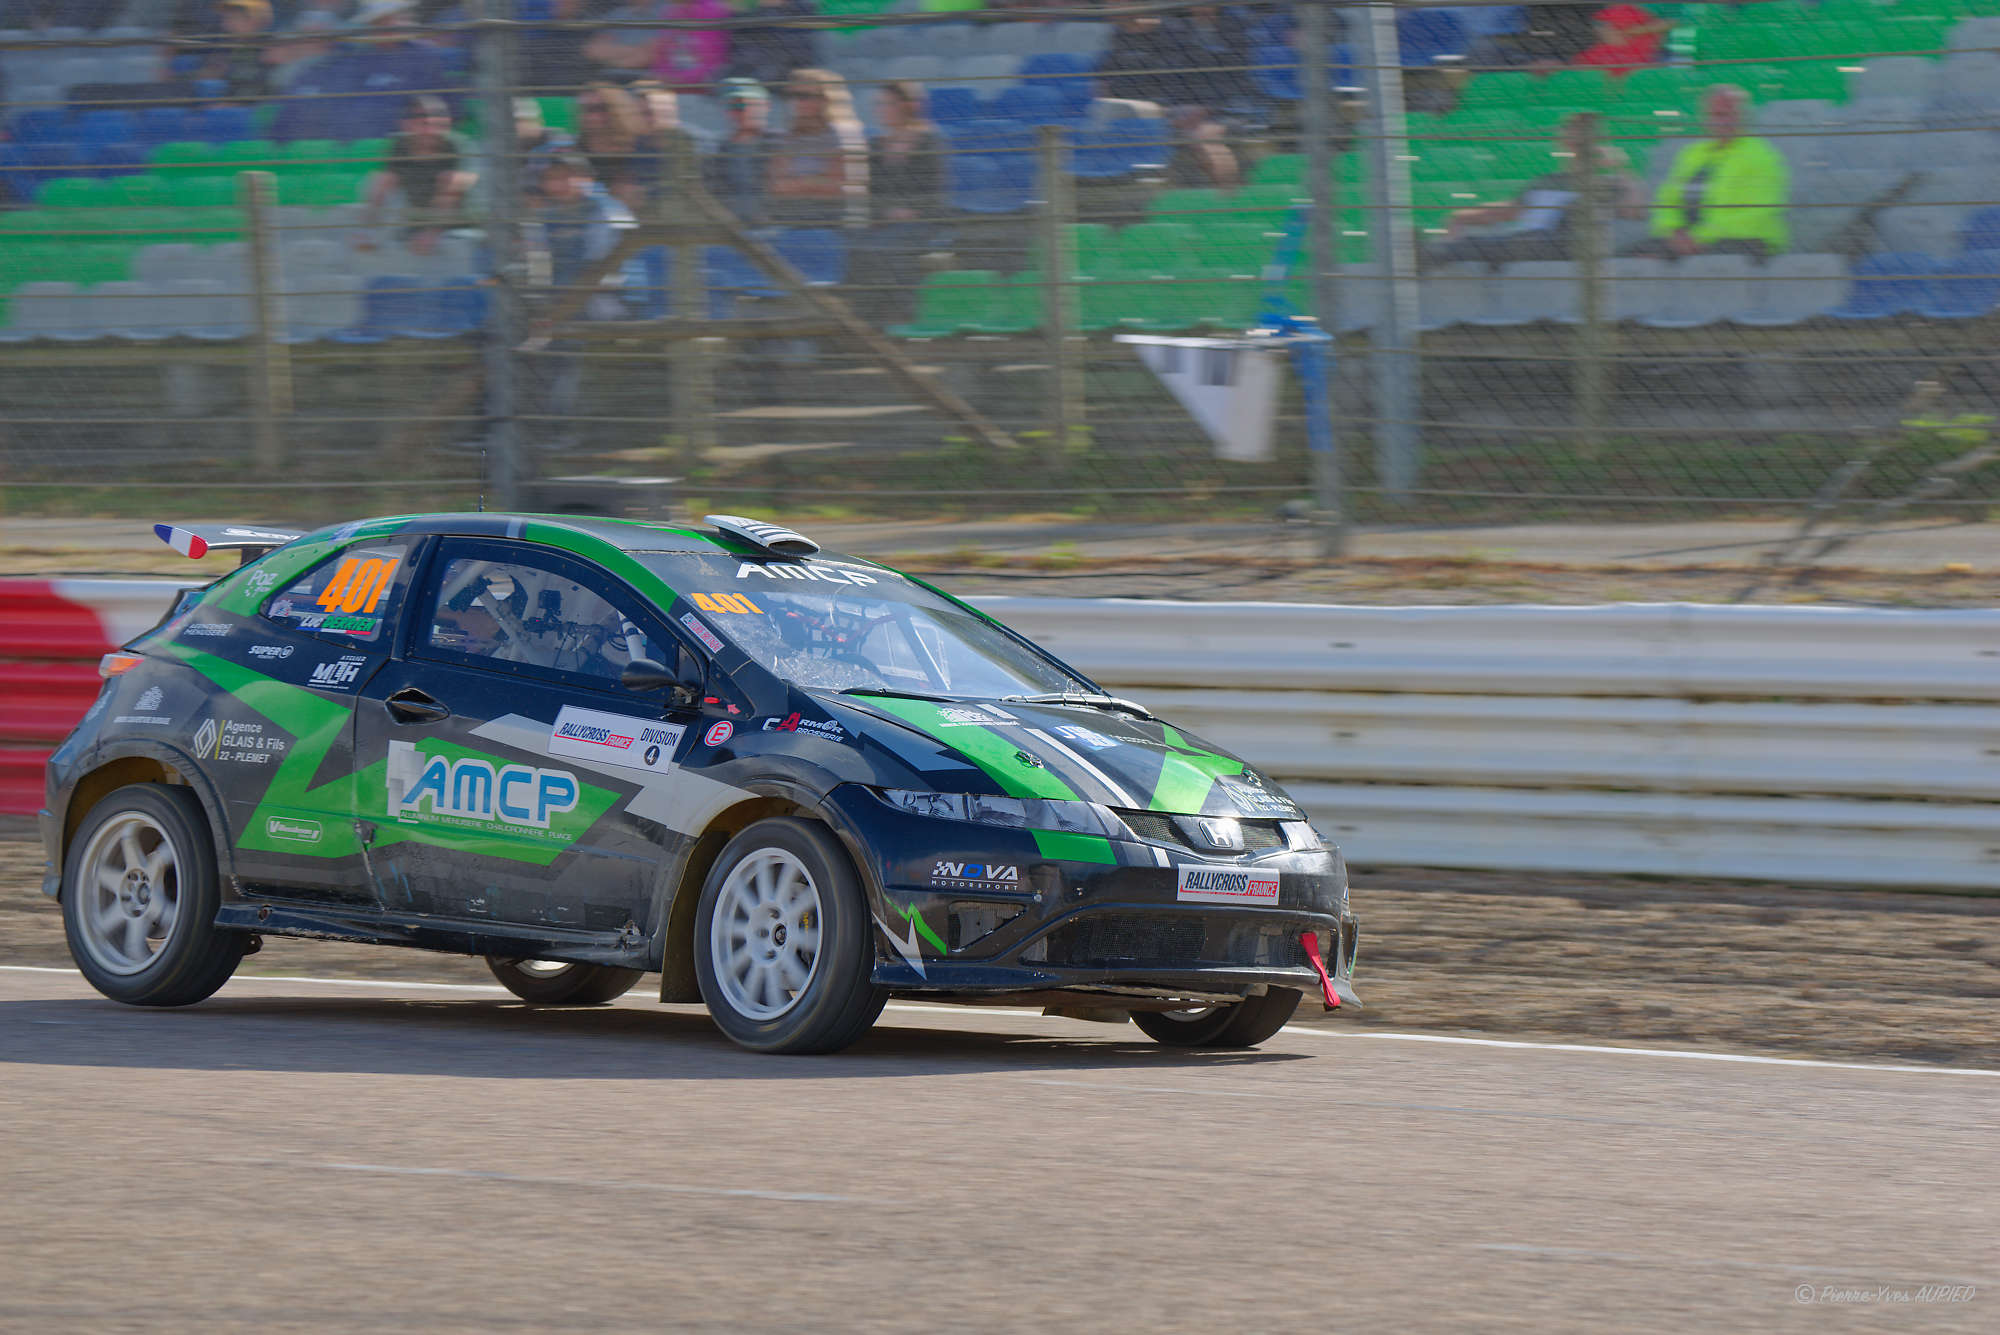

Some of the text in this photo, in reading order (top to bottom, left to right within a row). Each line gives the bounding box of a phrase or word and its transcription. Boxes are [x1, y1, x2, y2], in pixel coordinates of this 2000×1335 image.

[736, 561, 878, 587] AMCP
[316, 558, 400, 614] 401
[691, 593, 764, 614] 401
[248, 645, 282, 656] SUPER
[225, 719, 263, 734] Agence
[559, 722, 610, 742] RALLYCROSS
[710, 726, 728, 742] E
[222, 735, 285, 751] GLAIS & Fils
[640, 727, 679, 747] DIVISION
[219, 750, 230, 760] 22
[645, 747, 658, 764] 4
[401, 760, 576, 823] AMCP
[931, 880, 1018, 891] MOTORSPORT
[1185, 871, 1277, 897] RALLYCROSS FRANCE
